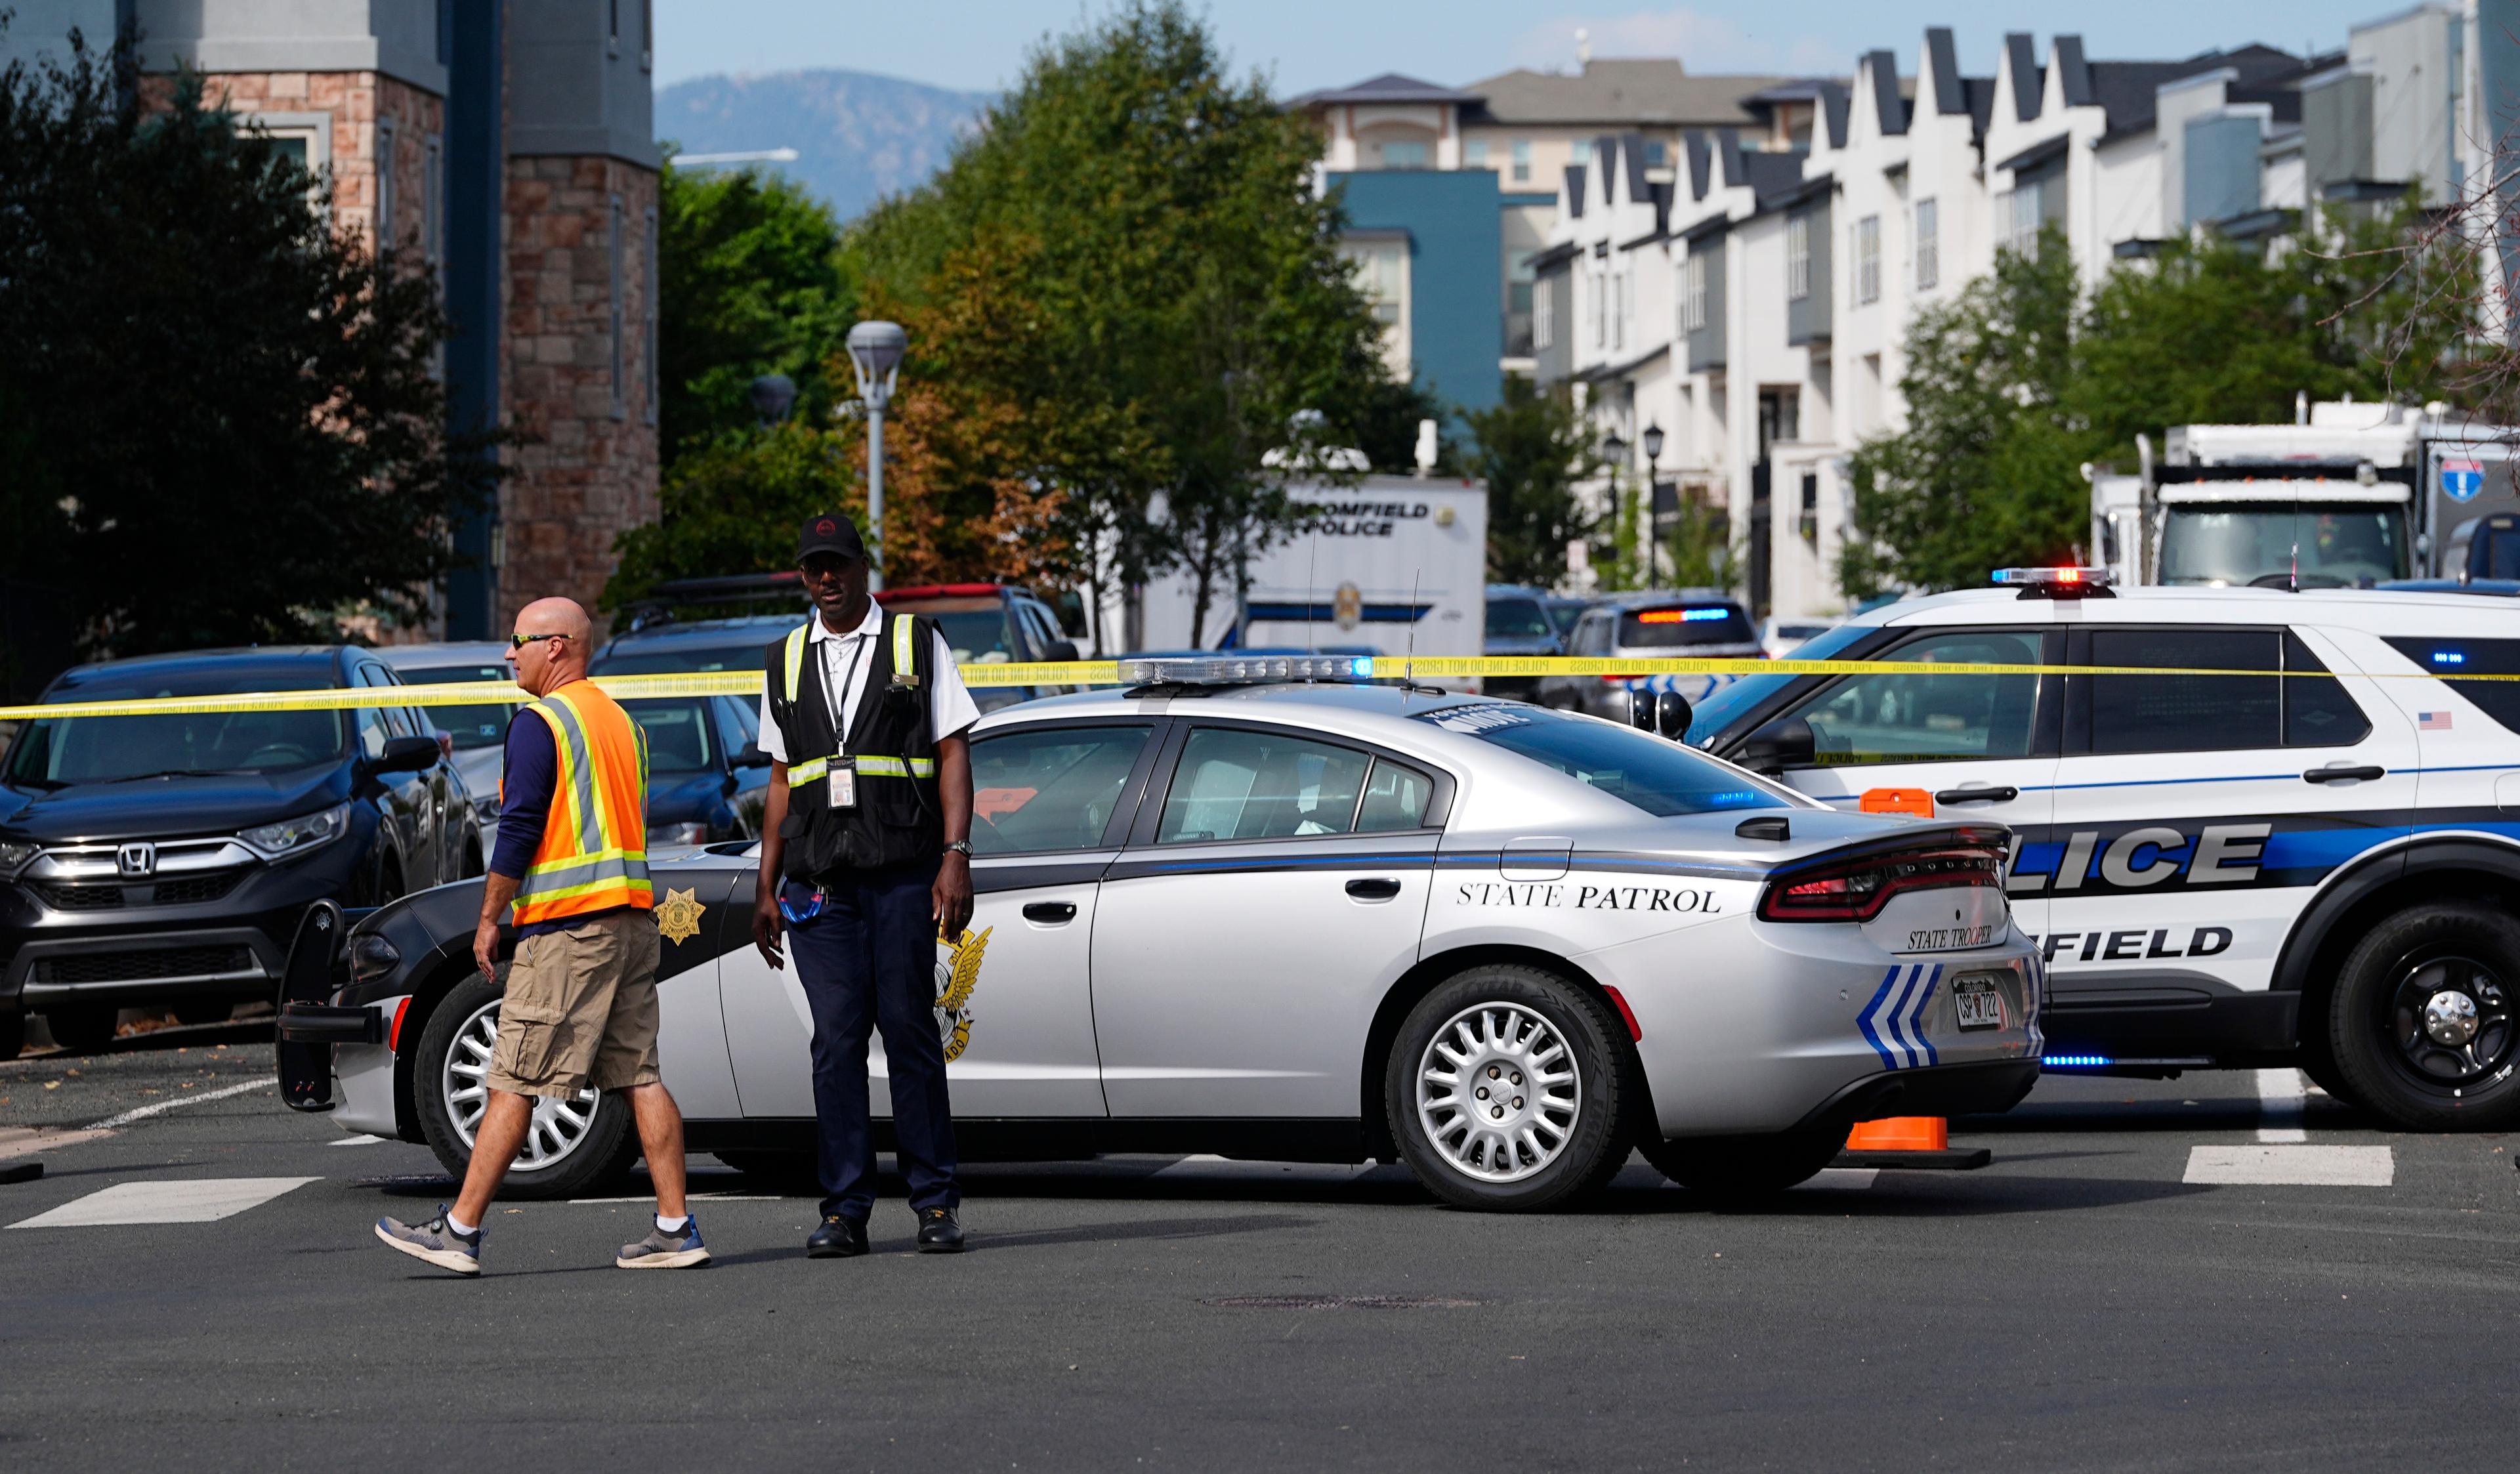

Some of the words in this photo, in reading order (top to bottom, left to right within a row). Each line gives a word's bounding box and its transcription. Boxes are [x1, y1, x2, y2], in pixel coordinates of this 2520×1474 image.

[1299, 502, 1429, 518] OMFIELD
[2006, 823, 2272, 892] LICE
[1456, 883, 1564, 908] STATE
[1575, 886, 1722, 914] PATROL
[1908, 930, 1948, 950] STATE
[1951, 925, 1992, 947] TROOPER
[2029, 927, 2233, 962] FIELD
[1959, 994, 1973, 1019] CSP
[1981, 992, 1998, 1018] 722
